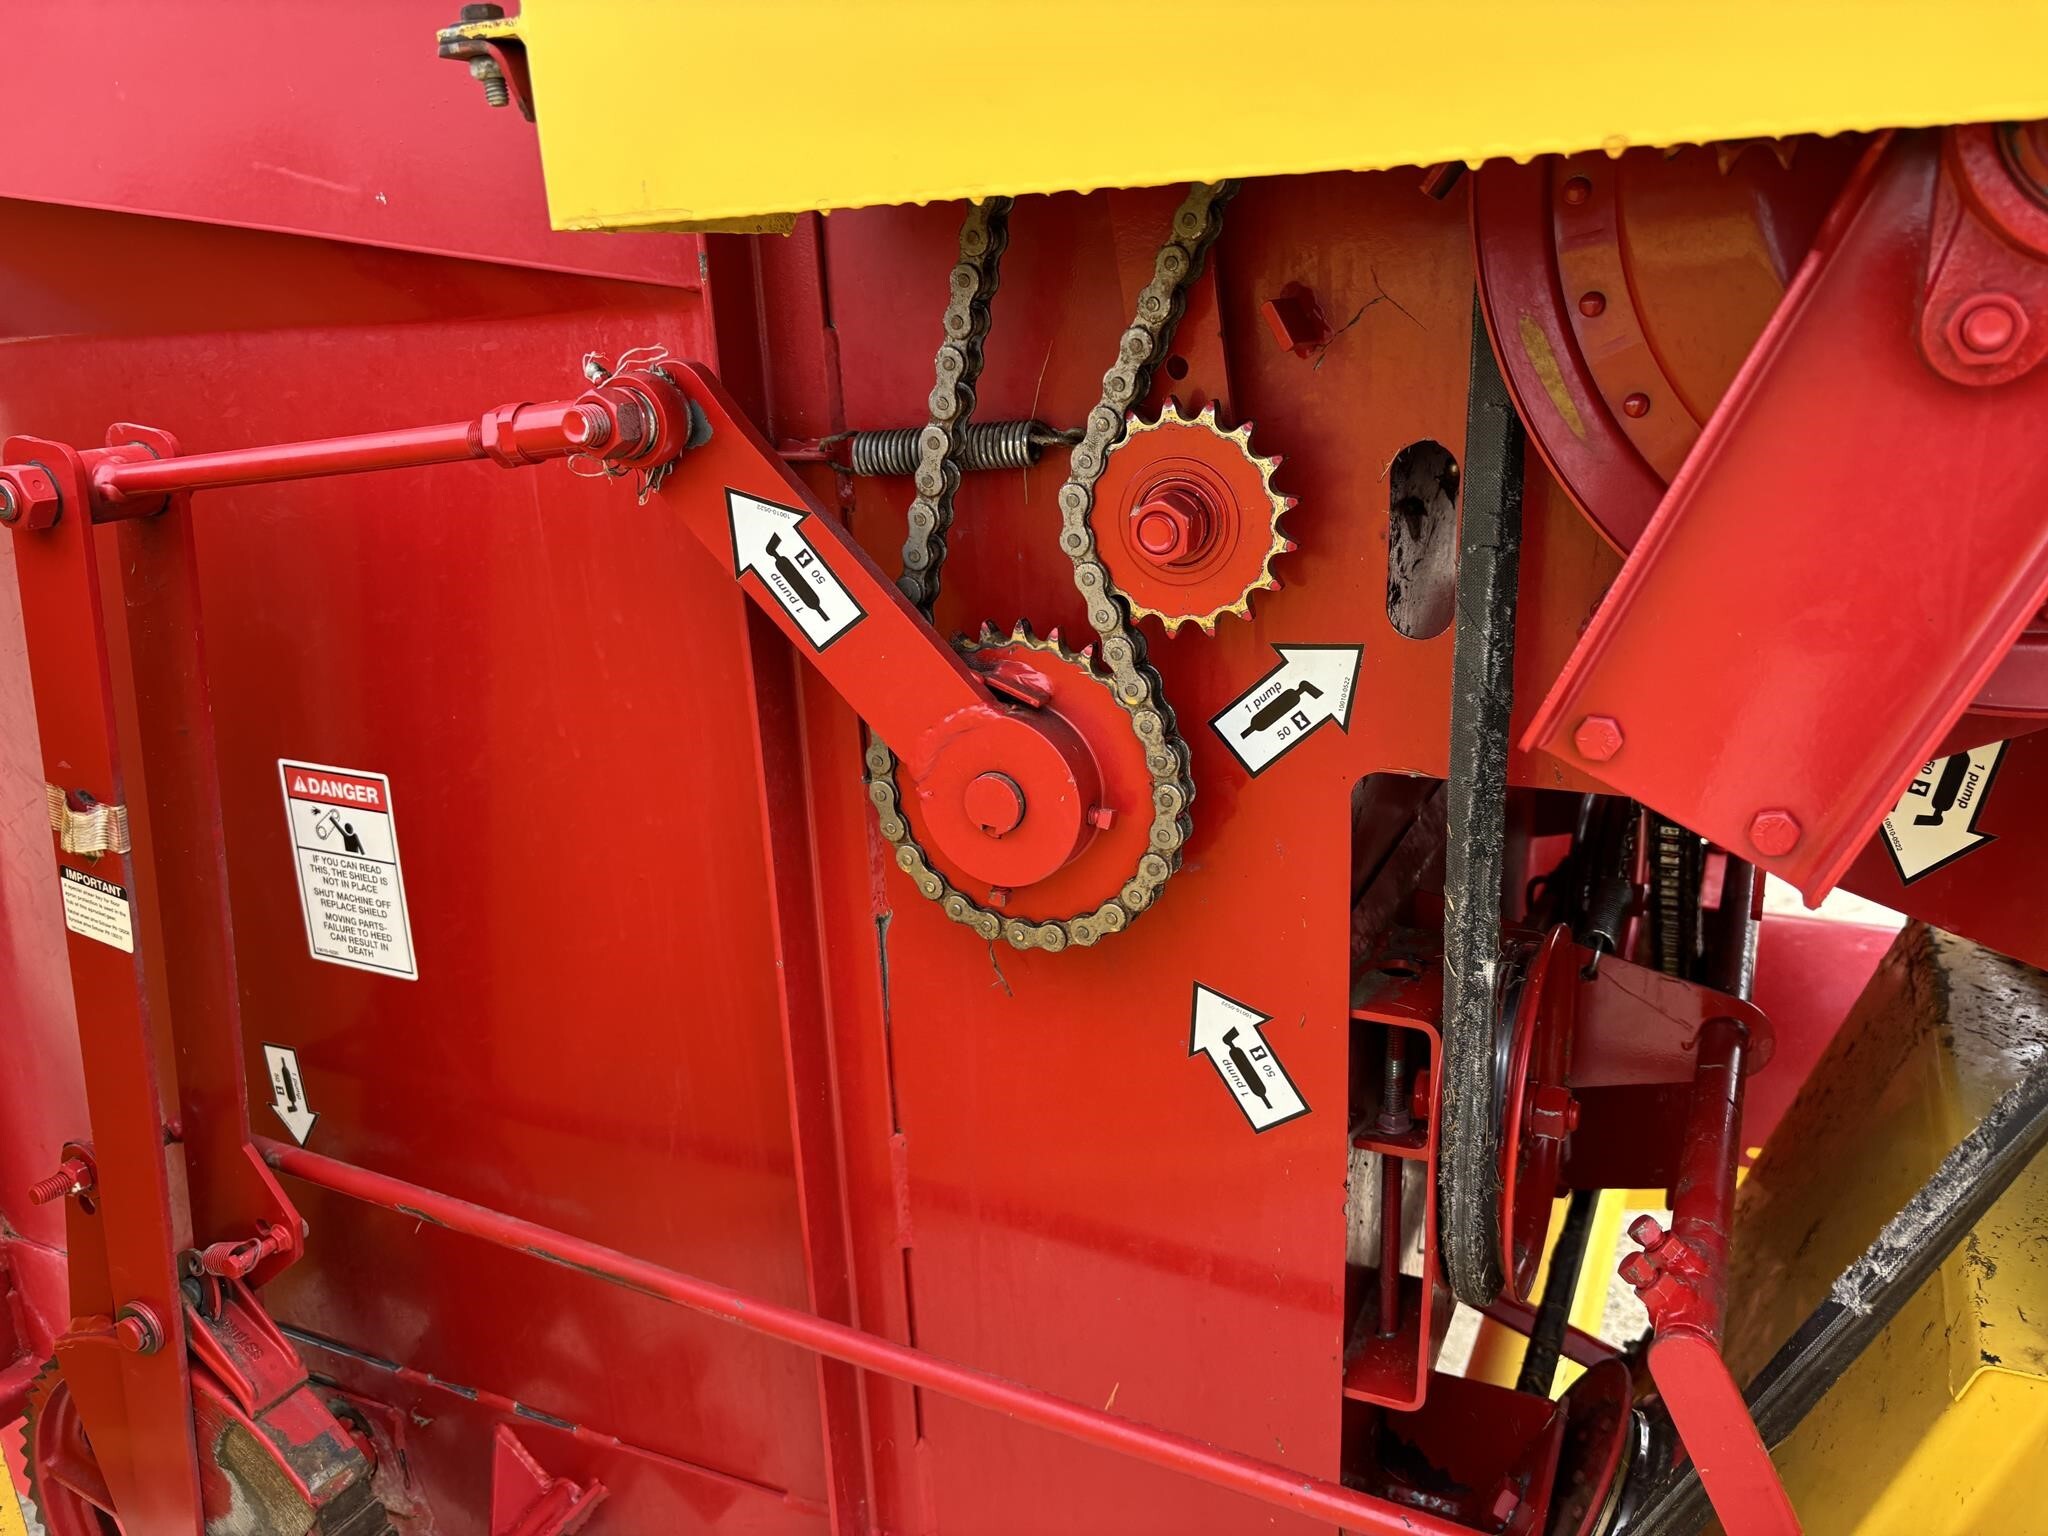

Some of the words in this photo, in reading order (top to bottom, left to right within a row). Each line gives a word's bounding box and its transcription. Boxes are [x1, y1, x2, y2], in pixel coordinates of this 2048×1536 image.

[811, 569, 826, 585] 50
[770, 573, 799, 604] pump
[1244, 704, 1252, 713] 1
[1253, 681, 1282, 710] pump
[1276, 726, 1291, 740] 50
[307, 778, 379, 804] DANGER
[1957, 772, 1979, 809] pump
[1884, 818, 1902, 851] 10010-0522
[310, 864, 330, 876] THIS,
[332, 868, 347, 878] THE
[349, 871, 378, 883] SHIELD
[380, 877, 388, 885] IS
[321, 856, 338, 866] YOU
[340, 860, 357, 870] CAN
[360, 863, 381, 874] READ
[65, 868, 121, 897] IMPORTANT
[323, 877, 338, 886] NOT
[342, 880, 349, 888] IN
[352, 882, 378, 893] PLACE
[314, 888, 334, 898] SHUT
[337, 892, 373, 906] MACHINE
[376, 900, 391, 909] OFF
[321, 899, 357, 912] REPLACE
[359, 907, 387, 918] SHIELD
[326, 912, 356, 925] MOVING
[324, 922, 356, 935] FAILURE
[358, 928, 368, 937] TO
[371, 931, 392, 942] HEED
[330, 933, 346, 942] CAN
[349, 936, 378, 948] RESULT
[381, 943, 388, 951] IN
[348, 946, 374, 957] DEATH
[1222, 1059, 1246, 1089] pump
[1263, 1064, 1276, 1078] 50
